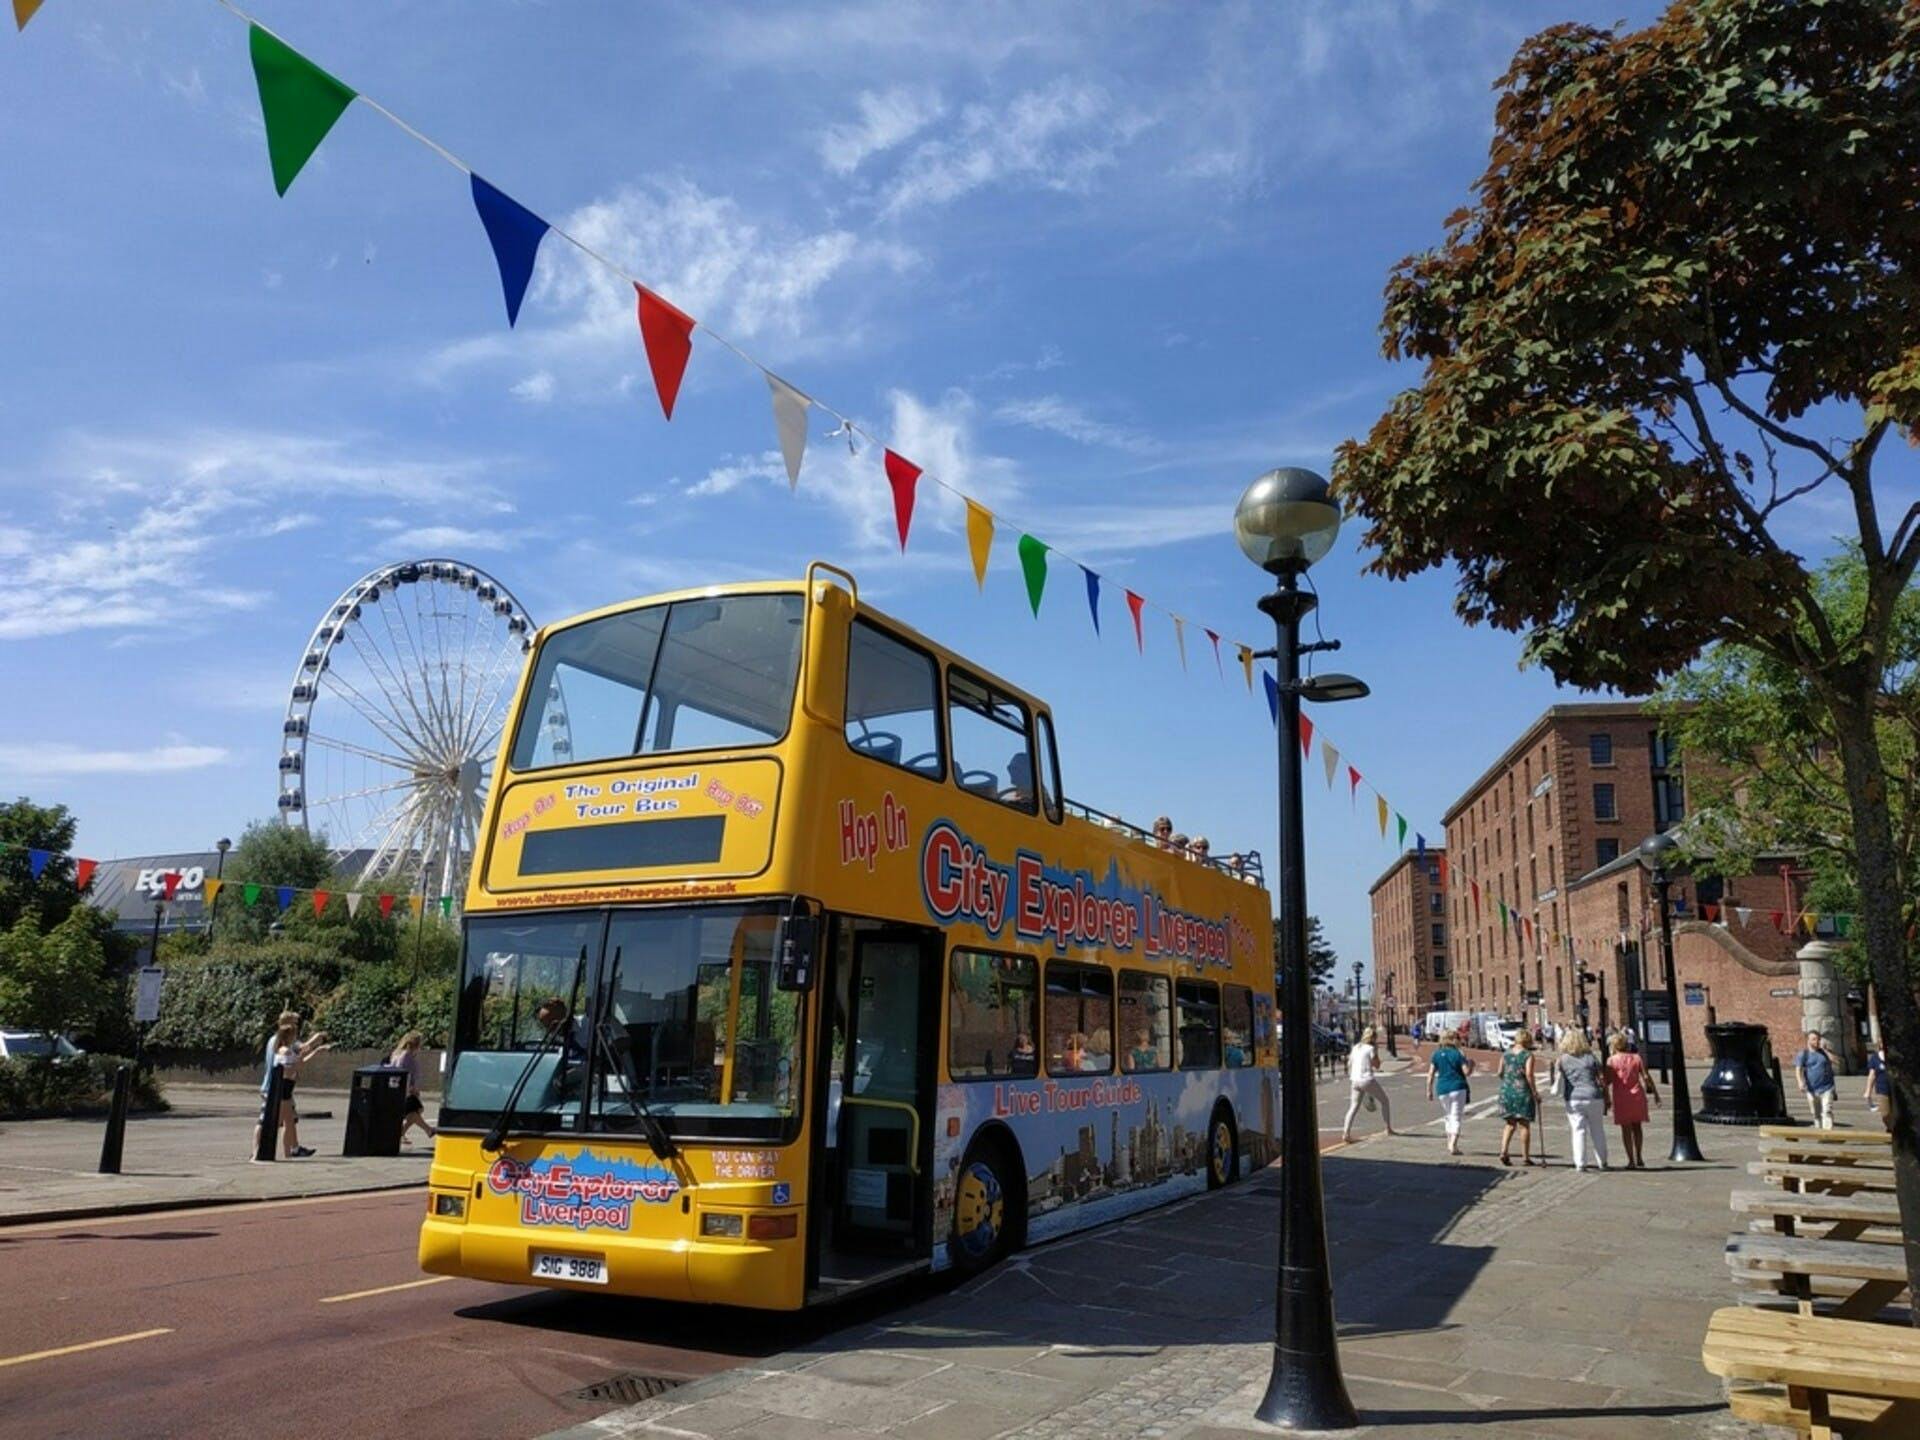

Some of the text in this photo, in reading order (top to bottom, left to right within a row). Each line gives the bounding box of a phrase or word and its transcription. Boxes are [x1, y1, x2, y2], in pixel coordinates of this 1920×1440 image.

[563, 774, 698, 798] The Original
[576, 799, 679, 819] Tour Bus
[839, 792, 909, 872] Hop On
[925, 827, 1008, 932] City
[1017, 856, 1138, 950] Explorer
[1143, 895, 1232, 967] Liverpool
[995, 1083, 1041, 1118] Live
[1045, 1080, 1093, 1112] Tour
[1092, 1077, 1142, 1108] Guide
[715, 1165, 776, 1178] THE DRIVER
[523, 1199, 628, 1228] Liverpool
[541, 1257, 602, 1279] SIG 9881
